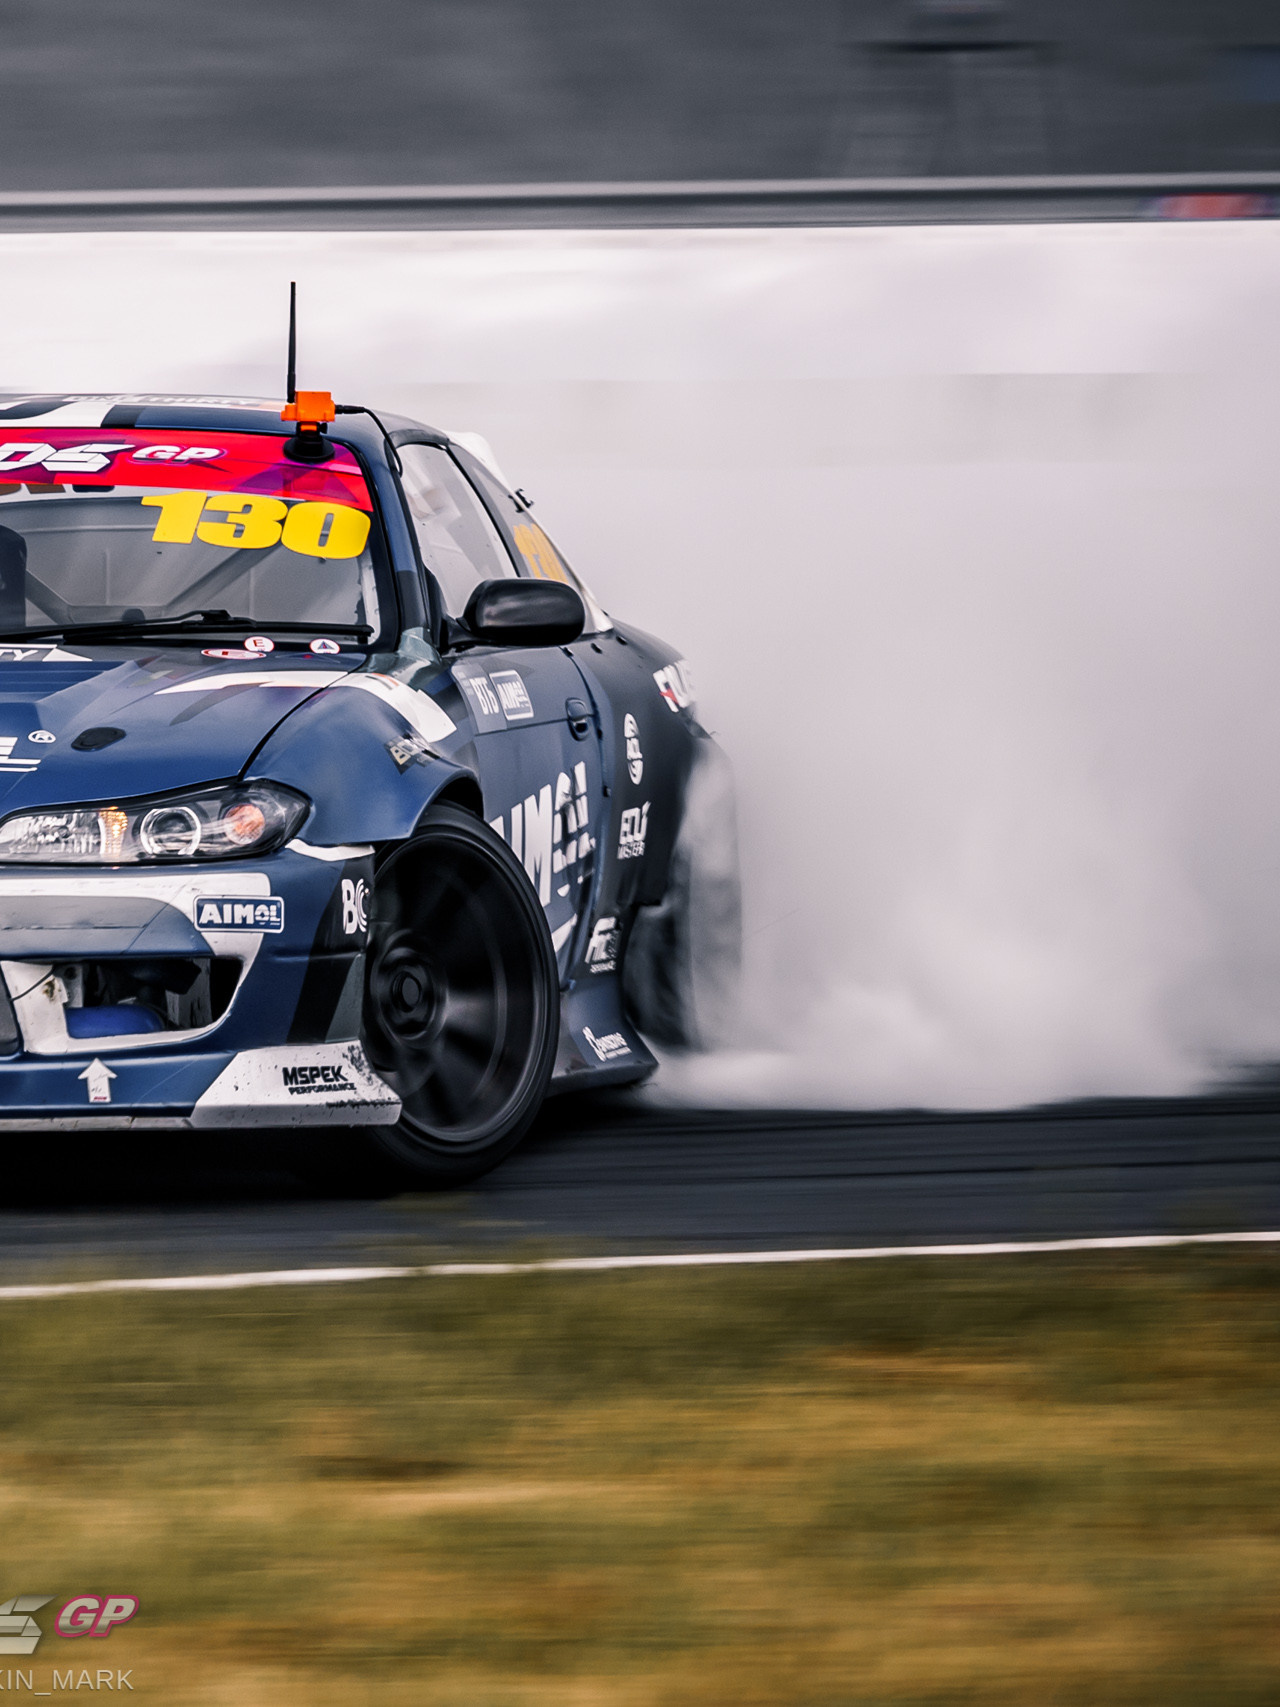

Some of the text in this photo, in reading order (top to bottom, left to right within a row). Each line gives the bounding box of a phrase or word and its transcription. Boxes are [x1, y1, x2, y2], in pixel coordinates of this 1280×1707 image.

[131, 445, 223, 465] GP
[140, 491, 371, 560] 130
[198, 903, 282, 926] AIMOL
[282, 1065, 349, 1087] MSPEK
[288, 1082, 358, 1096] PERFORMANCE
